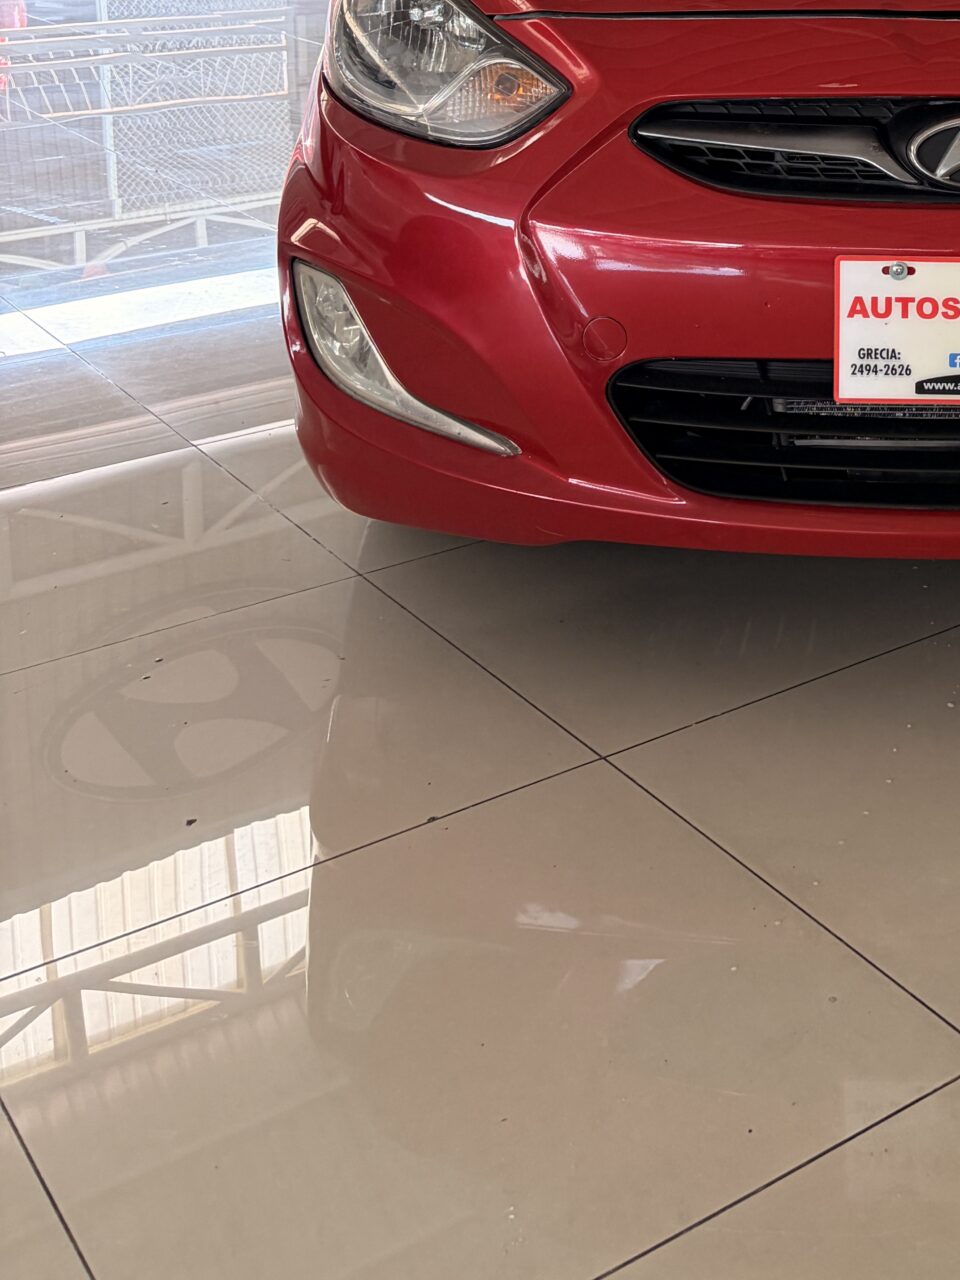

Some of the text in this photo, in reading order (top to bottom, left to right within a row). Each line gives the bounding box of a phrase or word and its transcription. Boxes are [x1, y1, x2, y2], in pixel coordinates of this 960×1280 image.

[847, 295, 960, 320] AUTOS
[857, 347, 901, 360] GRECIA:
[850, 363, 912, 376] 2494-2626
